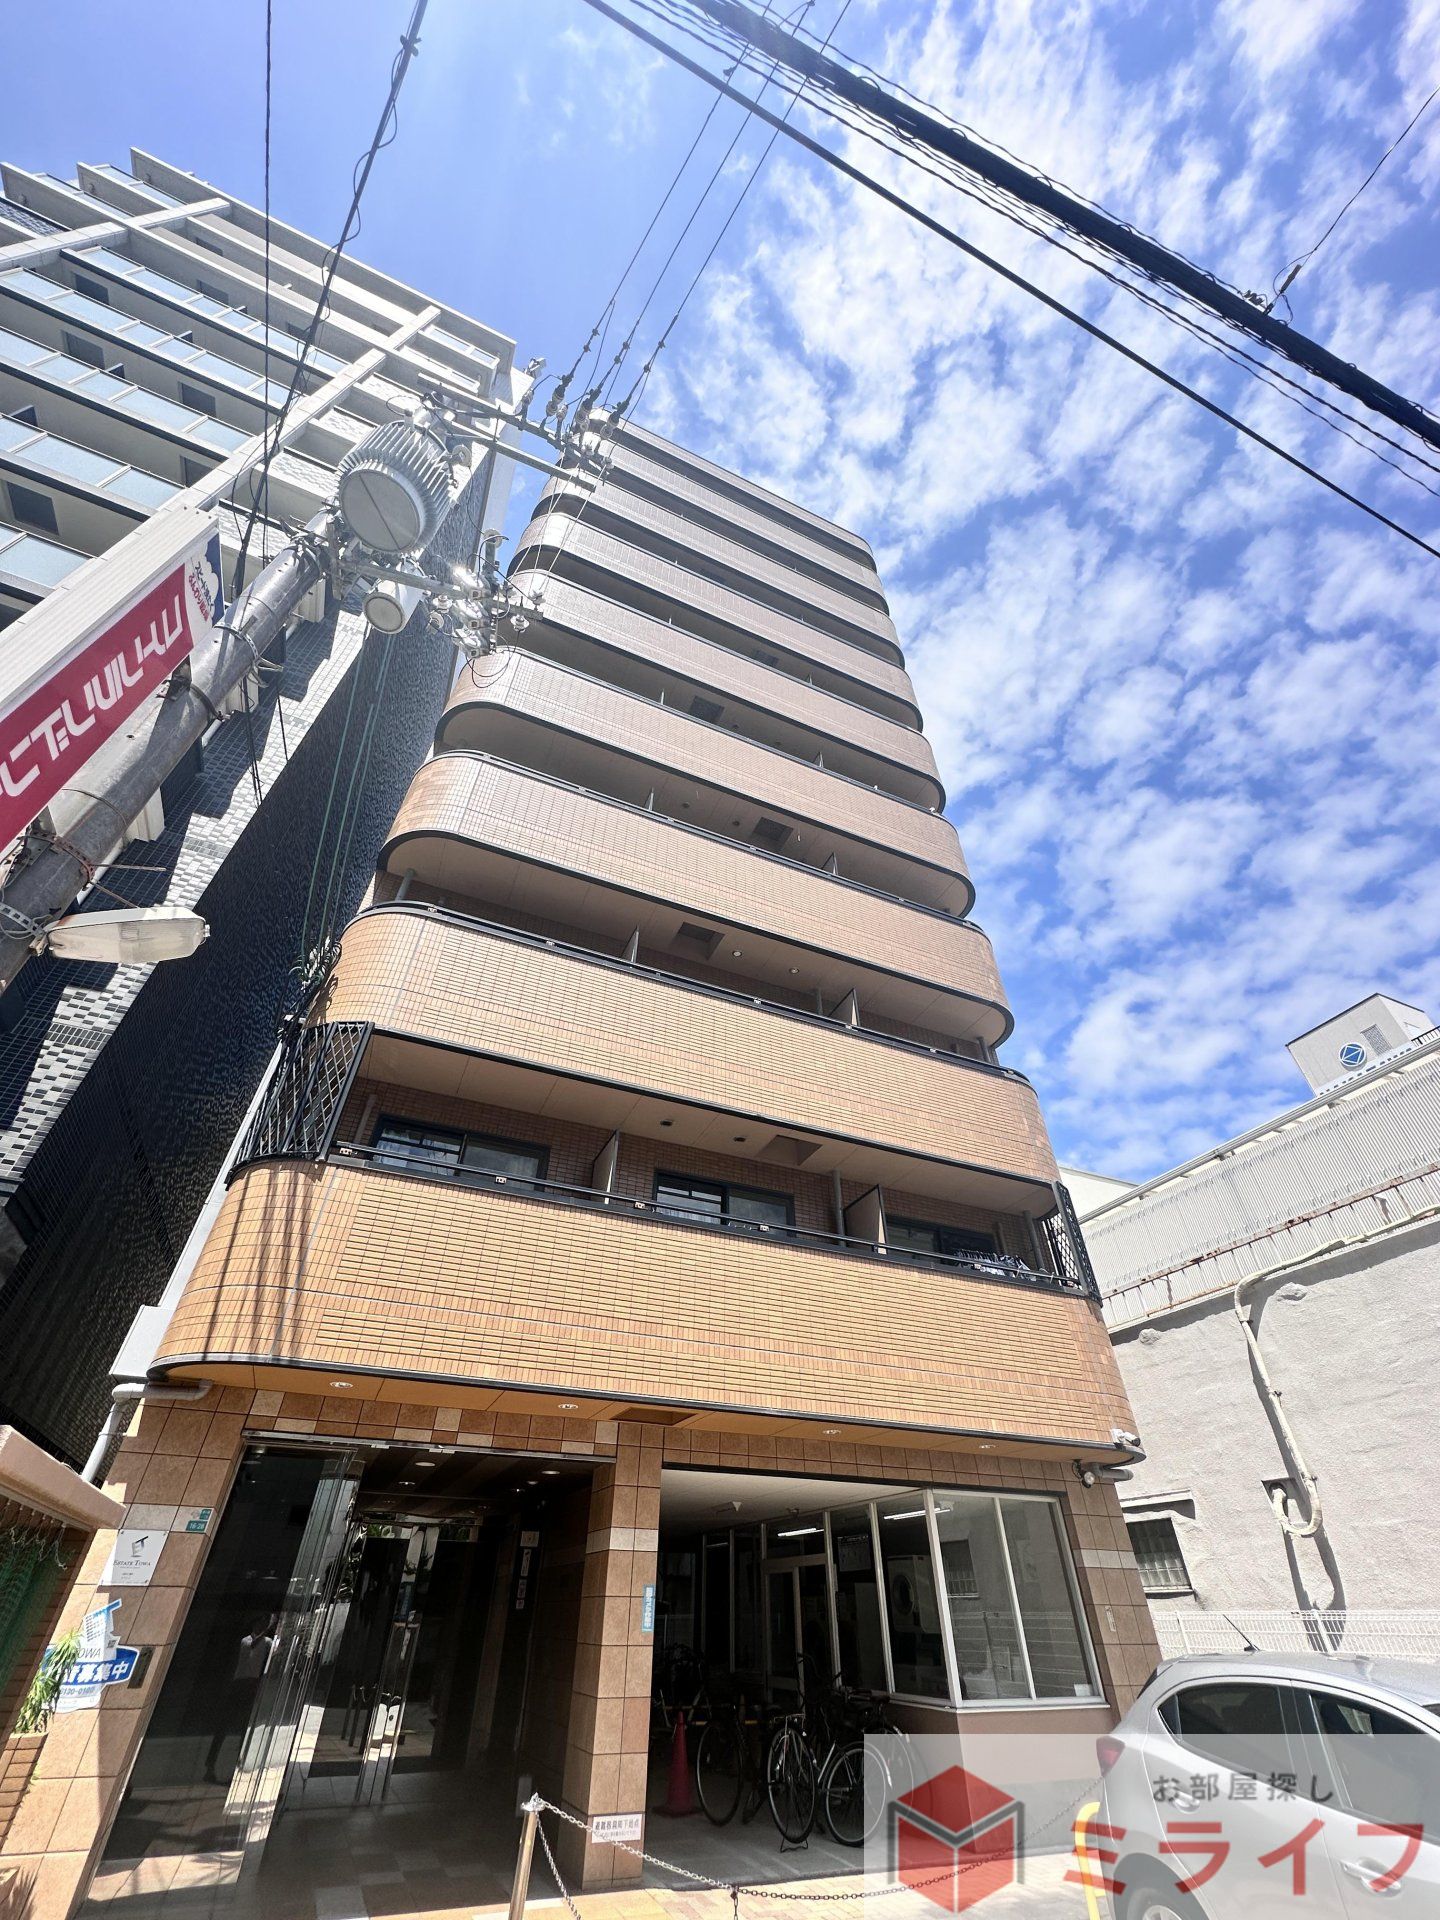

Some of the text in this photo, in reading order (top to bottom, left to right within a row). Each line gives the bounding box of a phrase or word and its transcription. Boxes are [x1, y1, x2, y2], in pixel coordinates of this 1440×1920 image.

[0, 594, 184, 798] コインランドリ
